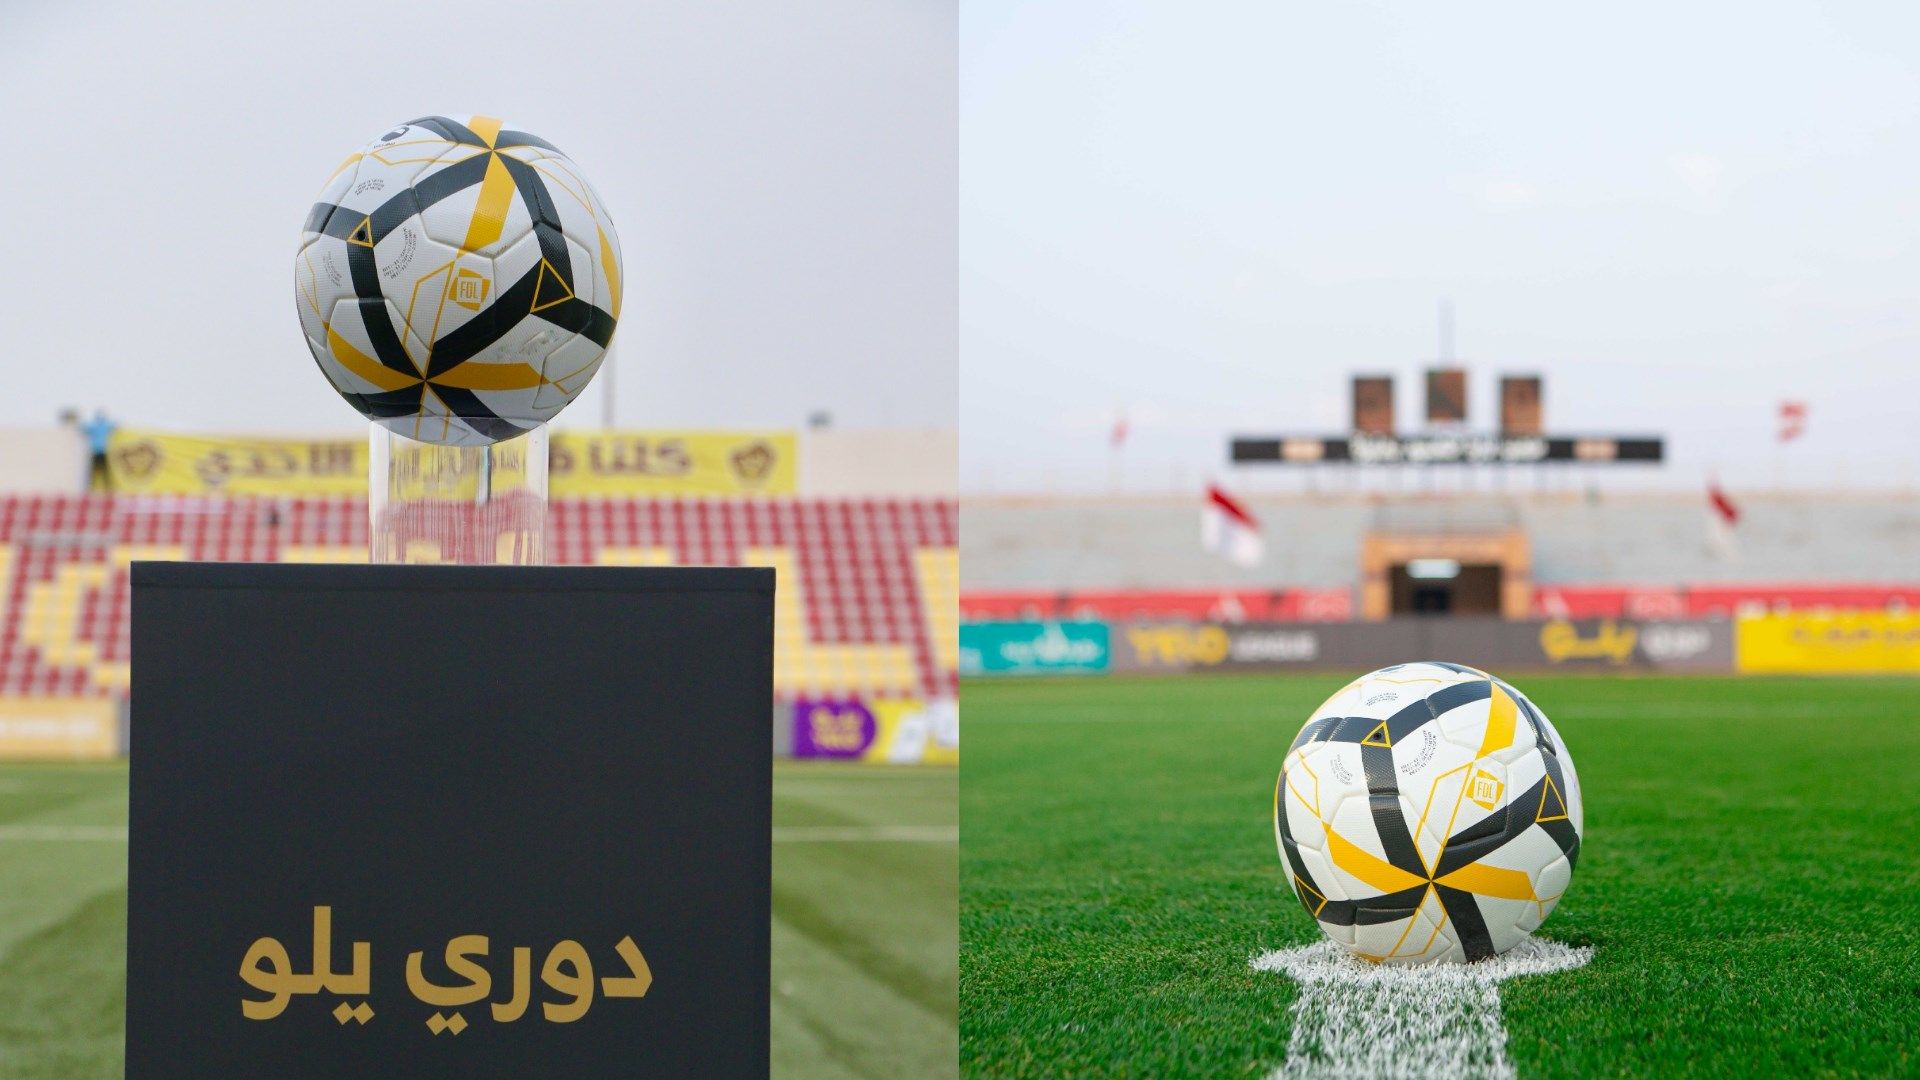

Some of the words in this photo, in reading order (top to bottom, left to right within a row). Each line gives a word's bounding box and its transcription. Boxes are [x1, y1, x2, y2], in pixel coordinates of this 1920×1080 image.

[460, 281, 478, 298] FDL
[1477, 781, 1494, 799] FDL
[239, 905, 375, 1026] يلو
[405, 934, 653, 1036] دوري
